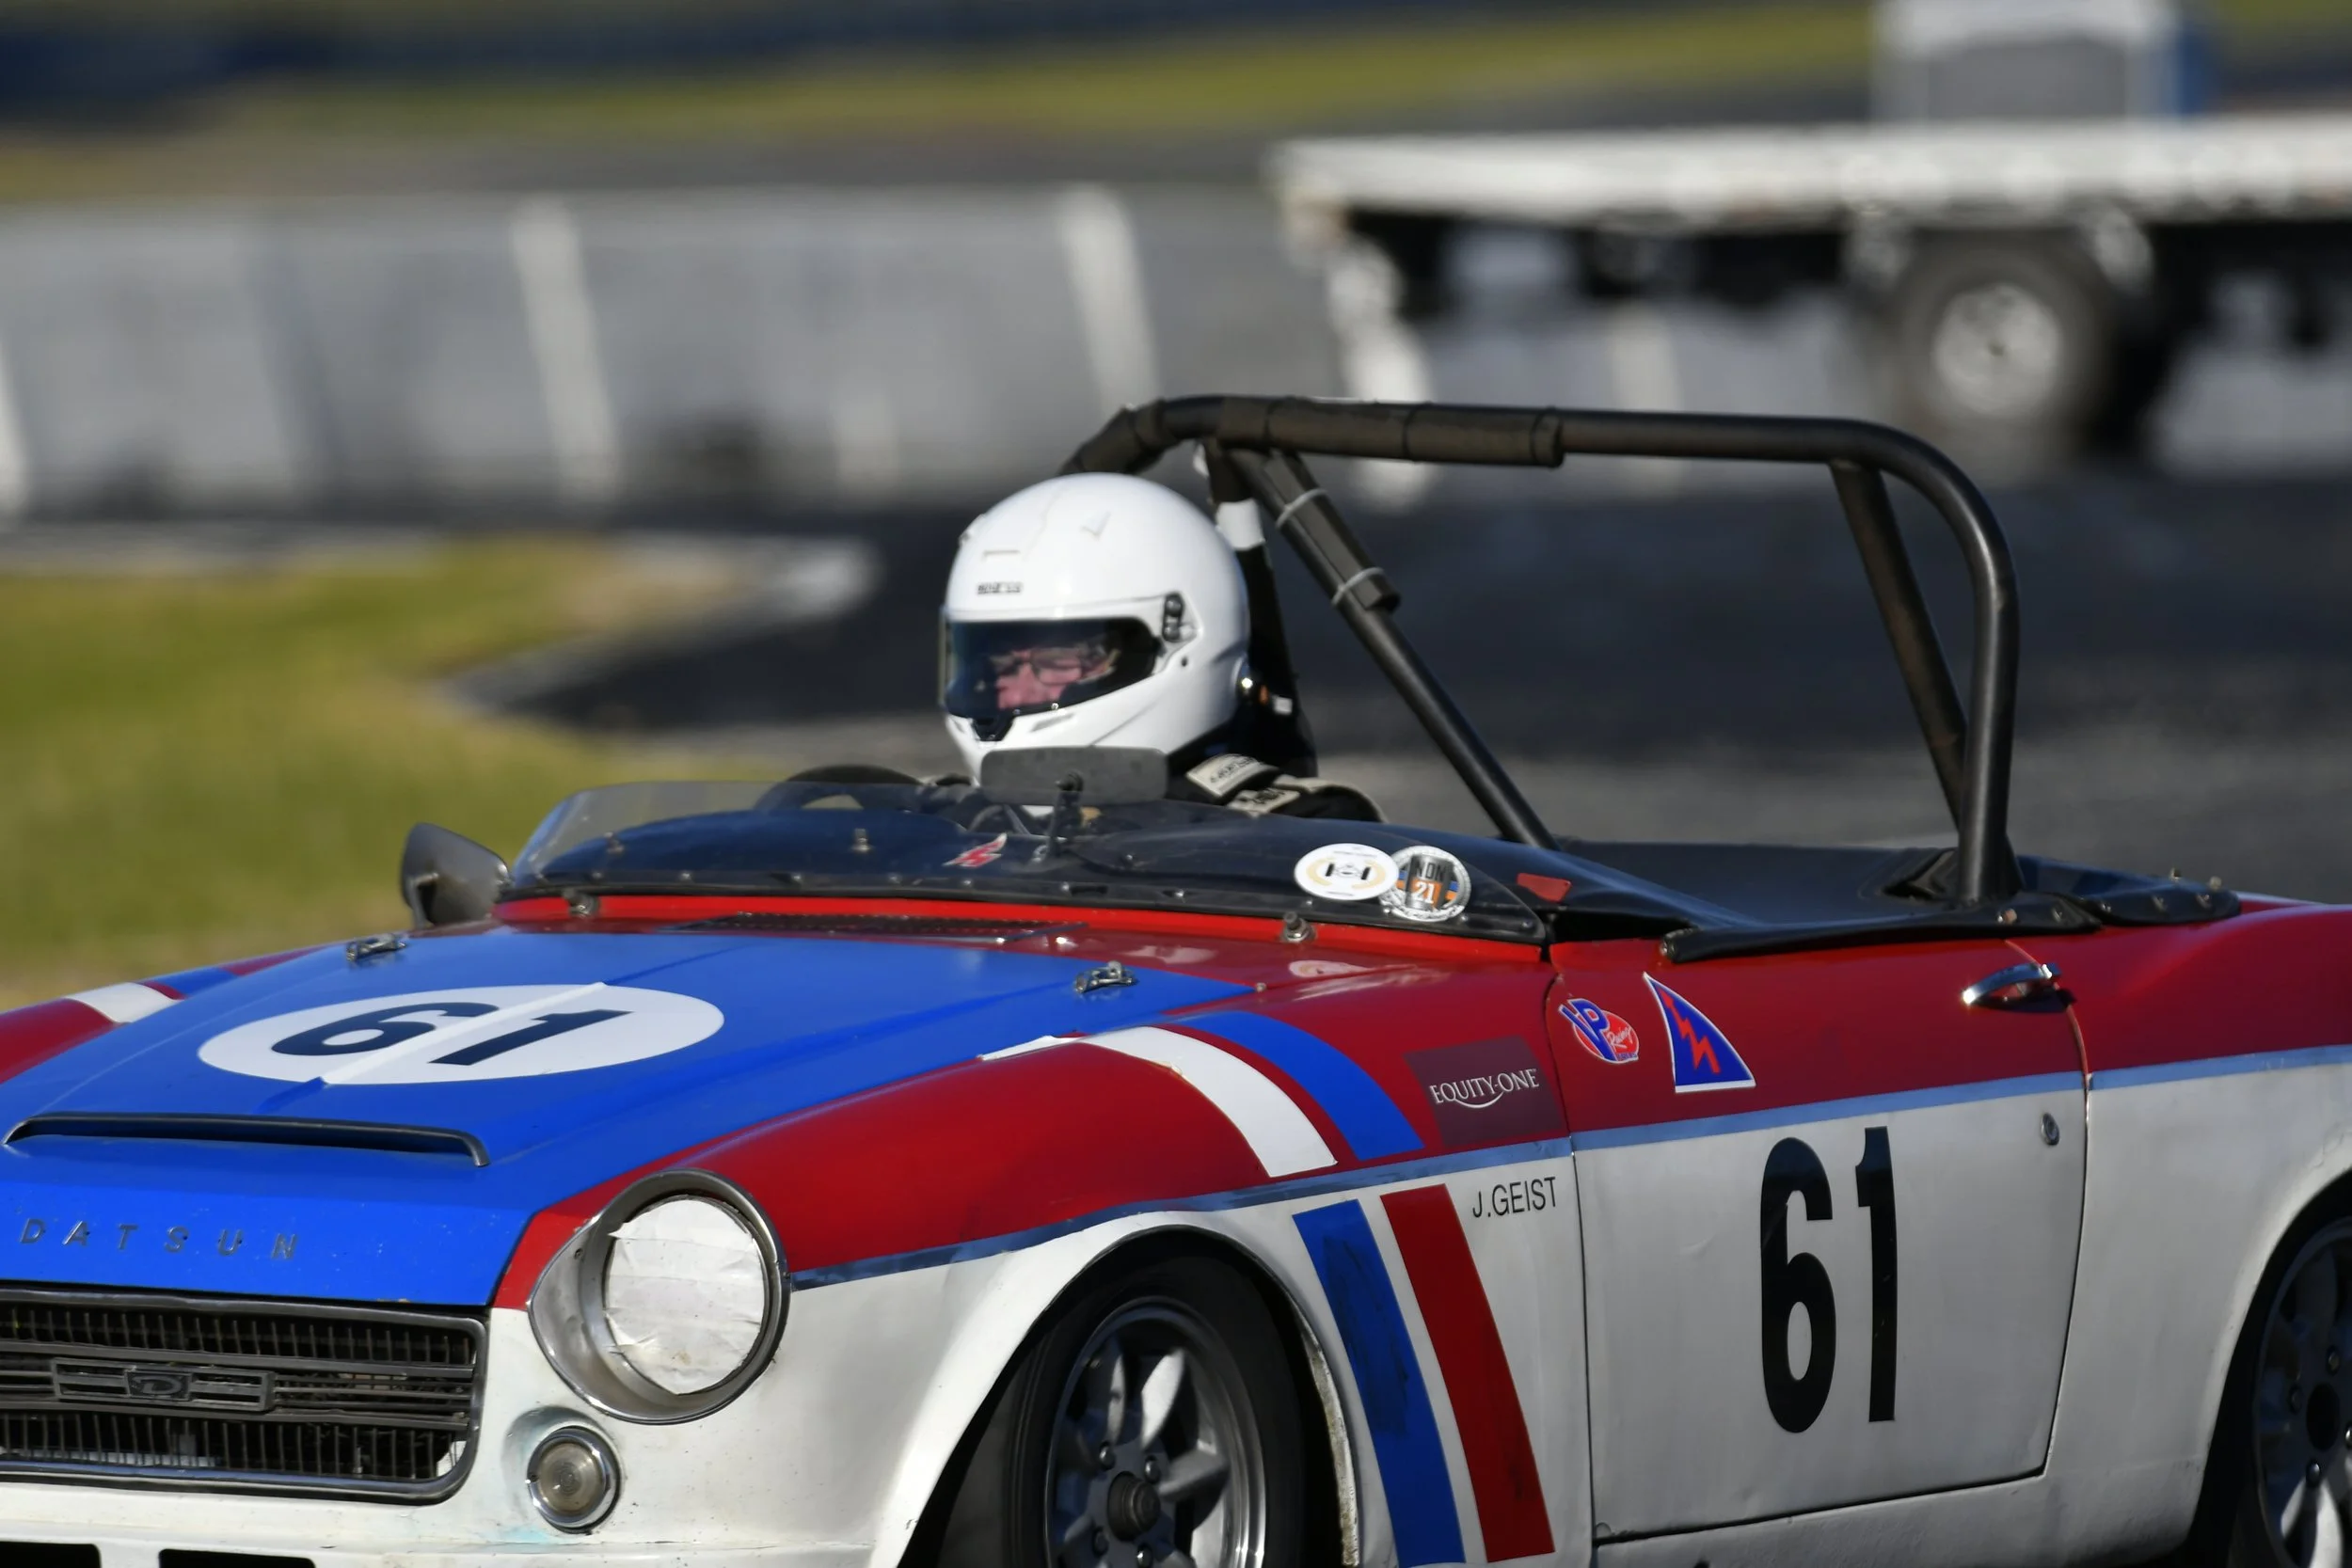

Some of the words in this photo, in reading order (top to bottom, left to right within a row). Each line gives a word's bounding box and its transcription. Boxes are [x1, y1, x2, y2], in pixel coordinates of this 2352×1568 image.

[1413, 881, 1436, 904] 21
[271, 1002, 634, 1066] 61
[1559, 998, 1617, 1062] VP
[1472, 1177, 1555, 1218] J.GEIST
[20, 1218, 297, 1259] DATSUN
[1760, 1126, 1898, 1433] 61
